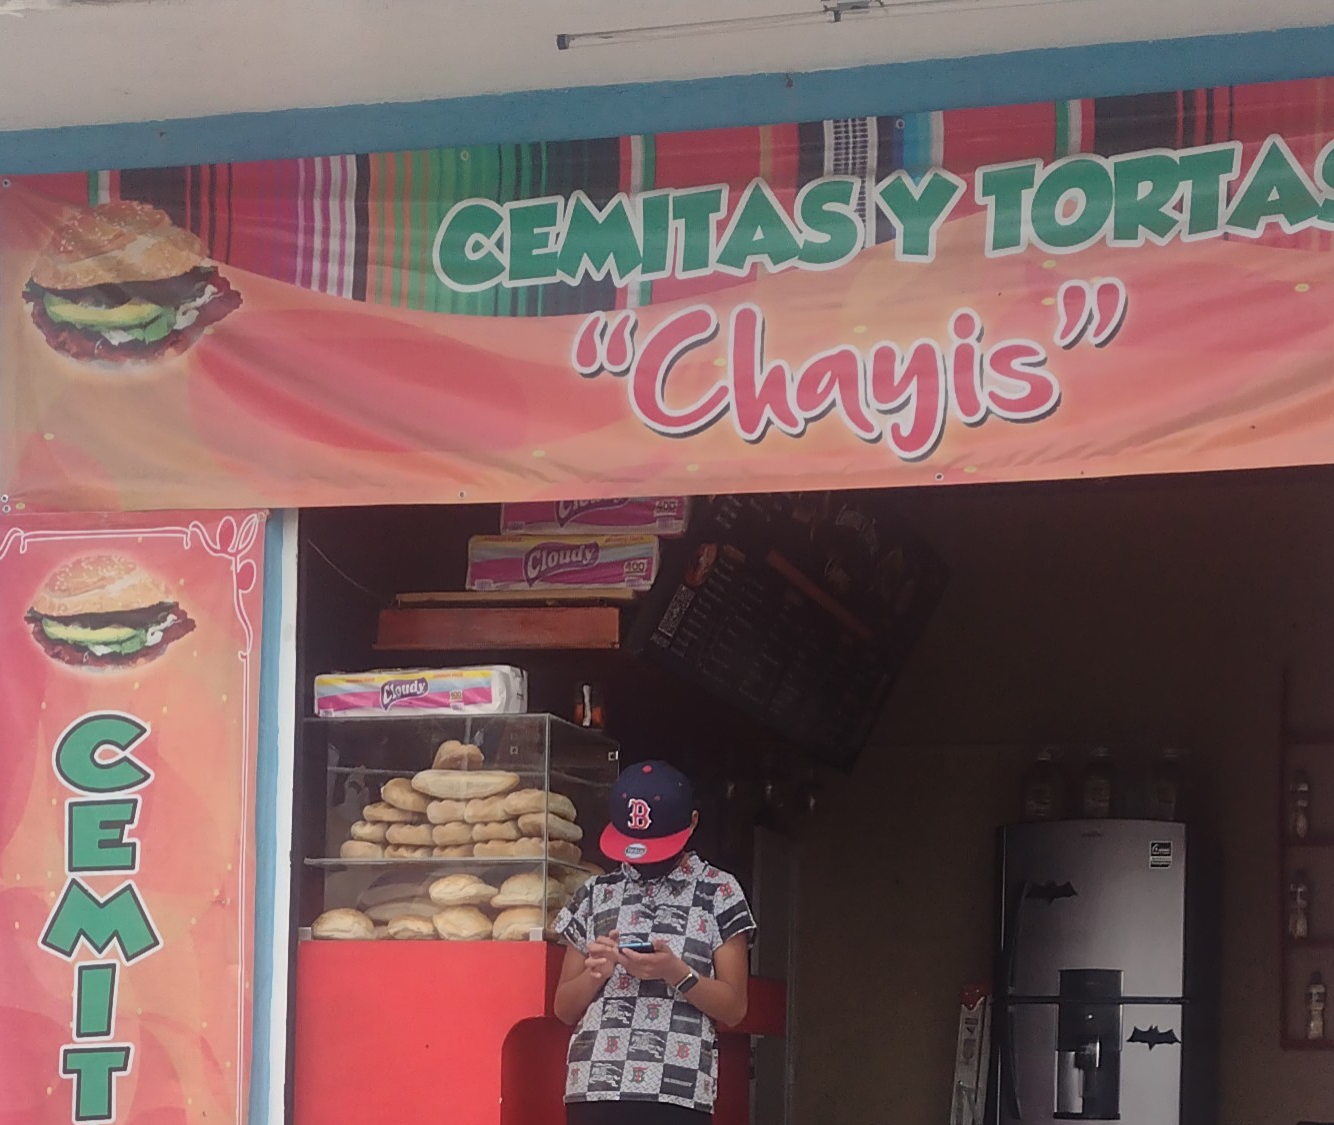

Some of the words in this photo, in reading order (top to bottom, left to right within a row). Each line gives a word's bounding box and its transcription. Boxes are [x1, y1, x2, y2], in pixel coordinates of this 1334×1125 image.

[434, 173, 865, 290] CEMITAS
[871, 169, 962, 261] Y
[526, 544, 595, 579] Cloudy
[383, 678, 427, 704] Cloudy
[627, 798, 652, 830] B
